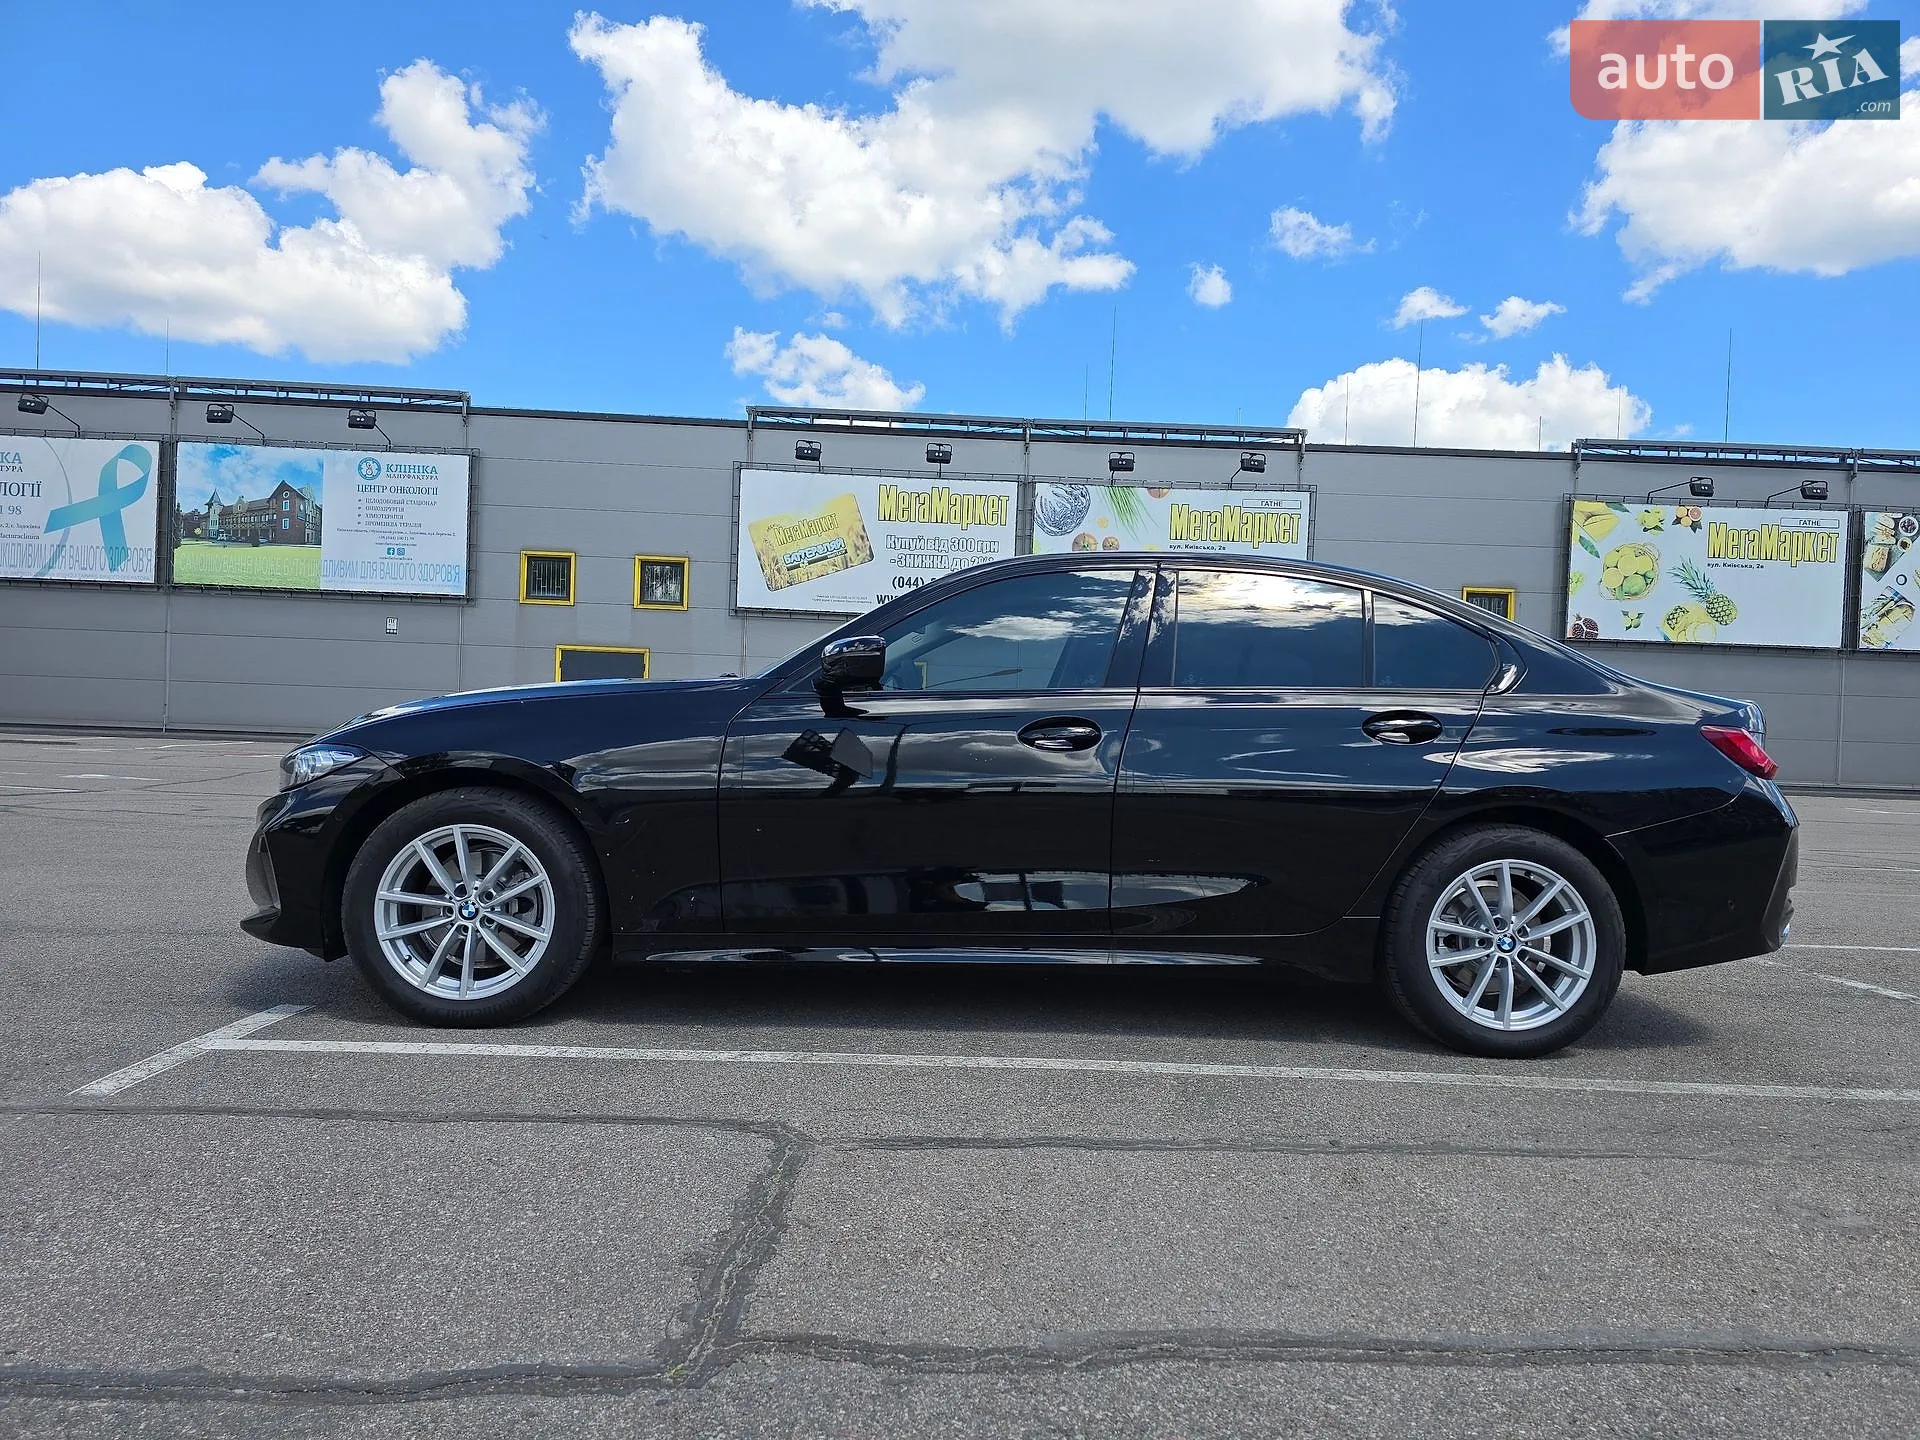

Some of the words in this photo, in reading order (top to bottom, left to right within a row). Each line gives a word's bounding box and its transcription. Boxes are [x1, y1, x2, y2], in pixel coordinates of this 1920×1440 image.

[385, 463, 439, 474] КЛІНІКА
[386, 473, 439, 481] МАНУФАКТУРА
[357, 484, 387, 494] ЦЕНТР
[389, 485, 438, 496] ОНКОЛОГІЇ
[8, 505, 22, 515] 98
[877, 484, 1009, 530] МегаМаркет
[774, 512, 839, 546] МегаМаркет
[1170, 504, 1302, 549] МегаМаркет
[886, 535, 925, 551] Купуй
[926, 537, 949, 553] від
[950, 536, 975, 552] 300
[977, 539, 999, 553] грн
[1707, 522, 1839, 567] МегаМаркет
[48, 544, 66, 570] ДЛЯ
[69, 545, 106, 571] ВАШОГО
[897, 553, 949, 569] ЗНИЖКА
[360, 560, 377, 579] ДЛЯ
[379, 561, 415, 581] ВАШОГО
[418, 564, 460, 583] ЗДОРОВ'Я
